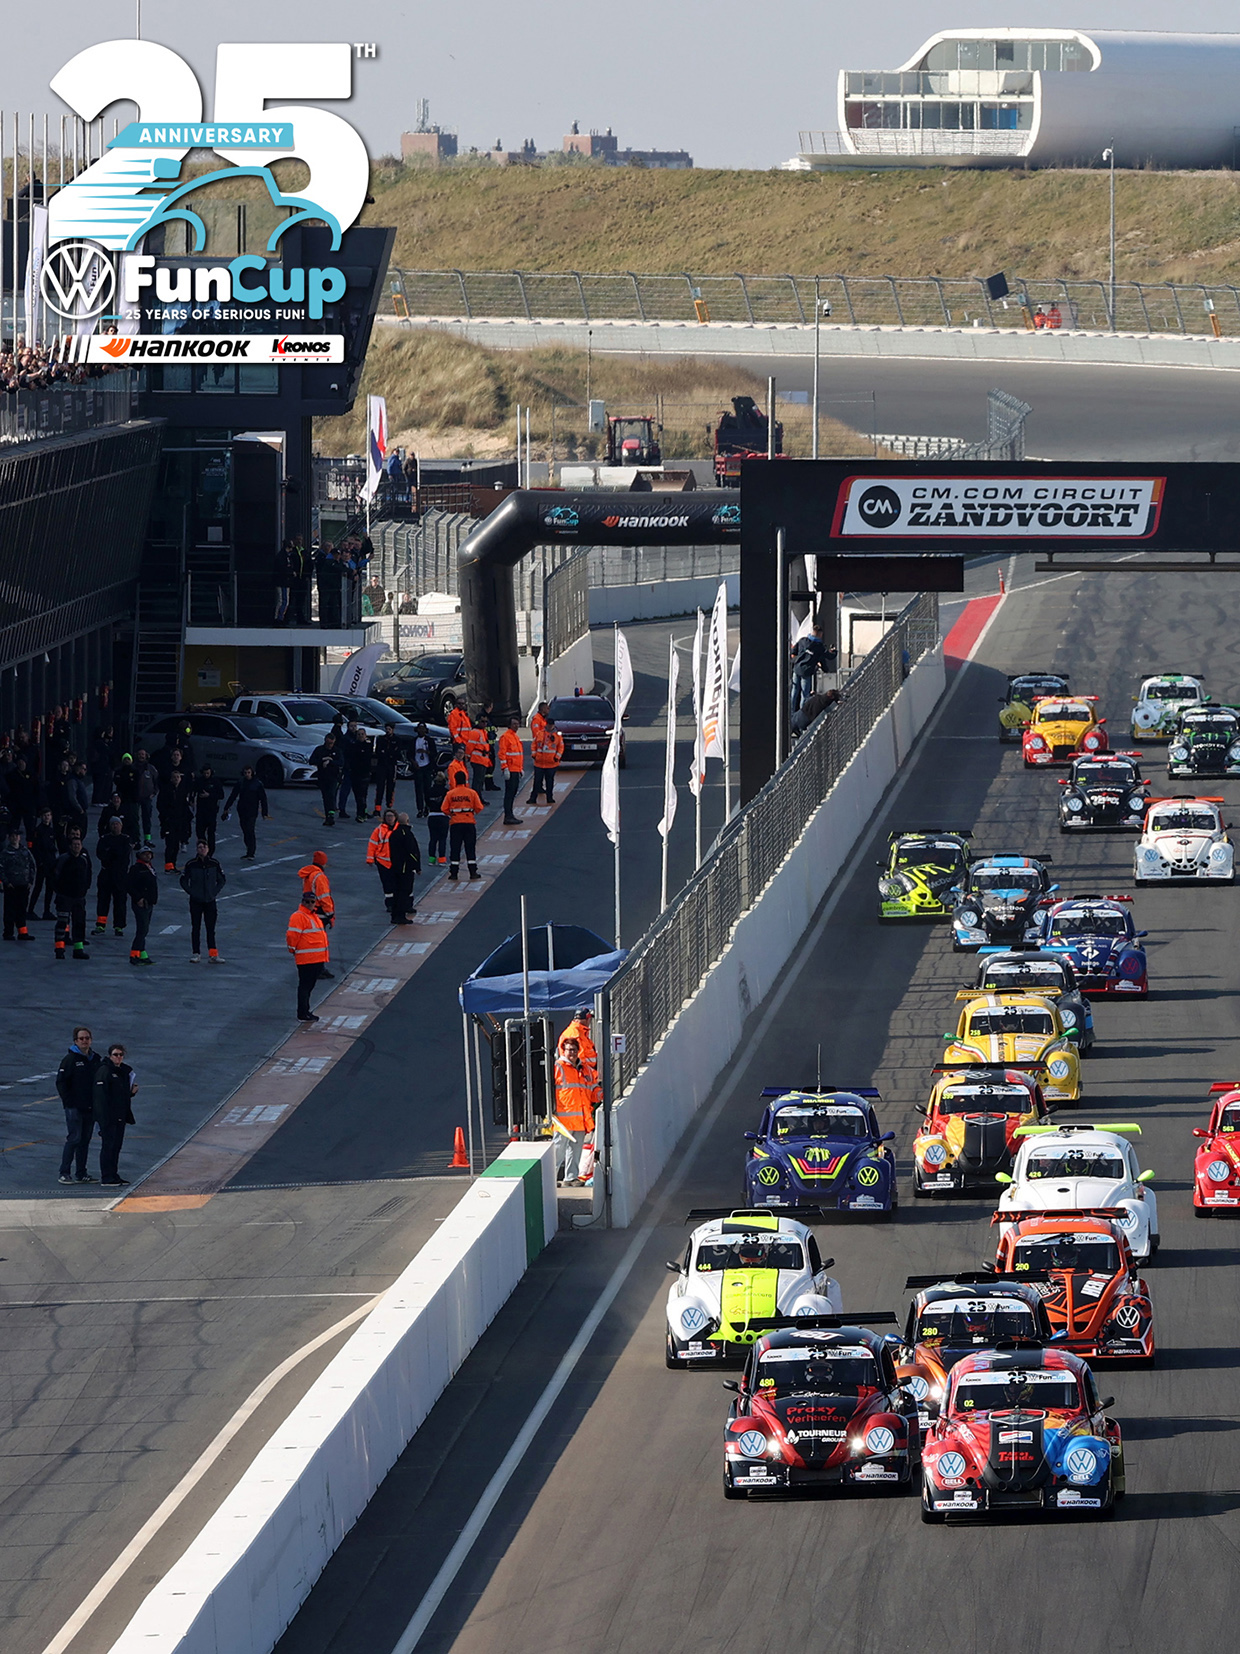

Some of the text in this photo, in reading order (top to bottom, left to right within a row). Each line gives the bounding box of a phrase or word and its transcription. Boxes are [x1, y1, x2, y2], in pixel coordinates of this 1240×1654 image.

[912, 487, 1143, 500] CM.COM CIRCUIT
[907, 502, 1140, 527] ZANDVOORT
[553, 517, 579, 525] FunCup
[1004, 1006, 1017, 1015] 25
[978, 1085, 994, 1095] 25
[1067, 1149, 1084, 1159] 25
[742, 1233, 760, 1244] 25
[968, 1301, 987, 1312] 25
[922, 1327, 938, 1336] 280
[1007, 1371, 1027, 1384] 25
[759, 1378, 775, 1387] 480
[963, 1399, 974, 1407] 02
[786, 1406, 837, 1415] Proxy
[797, 1429, 848, 1438] TOURNEUR
